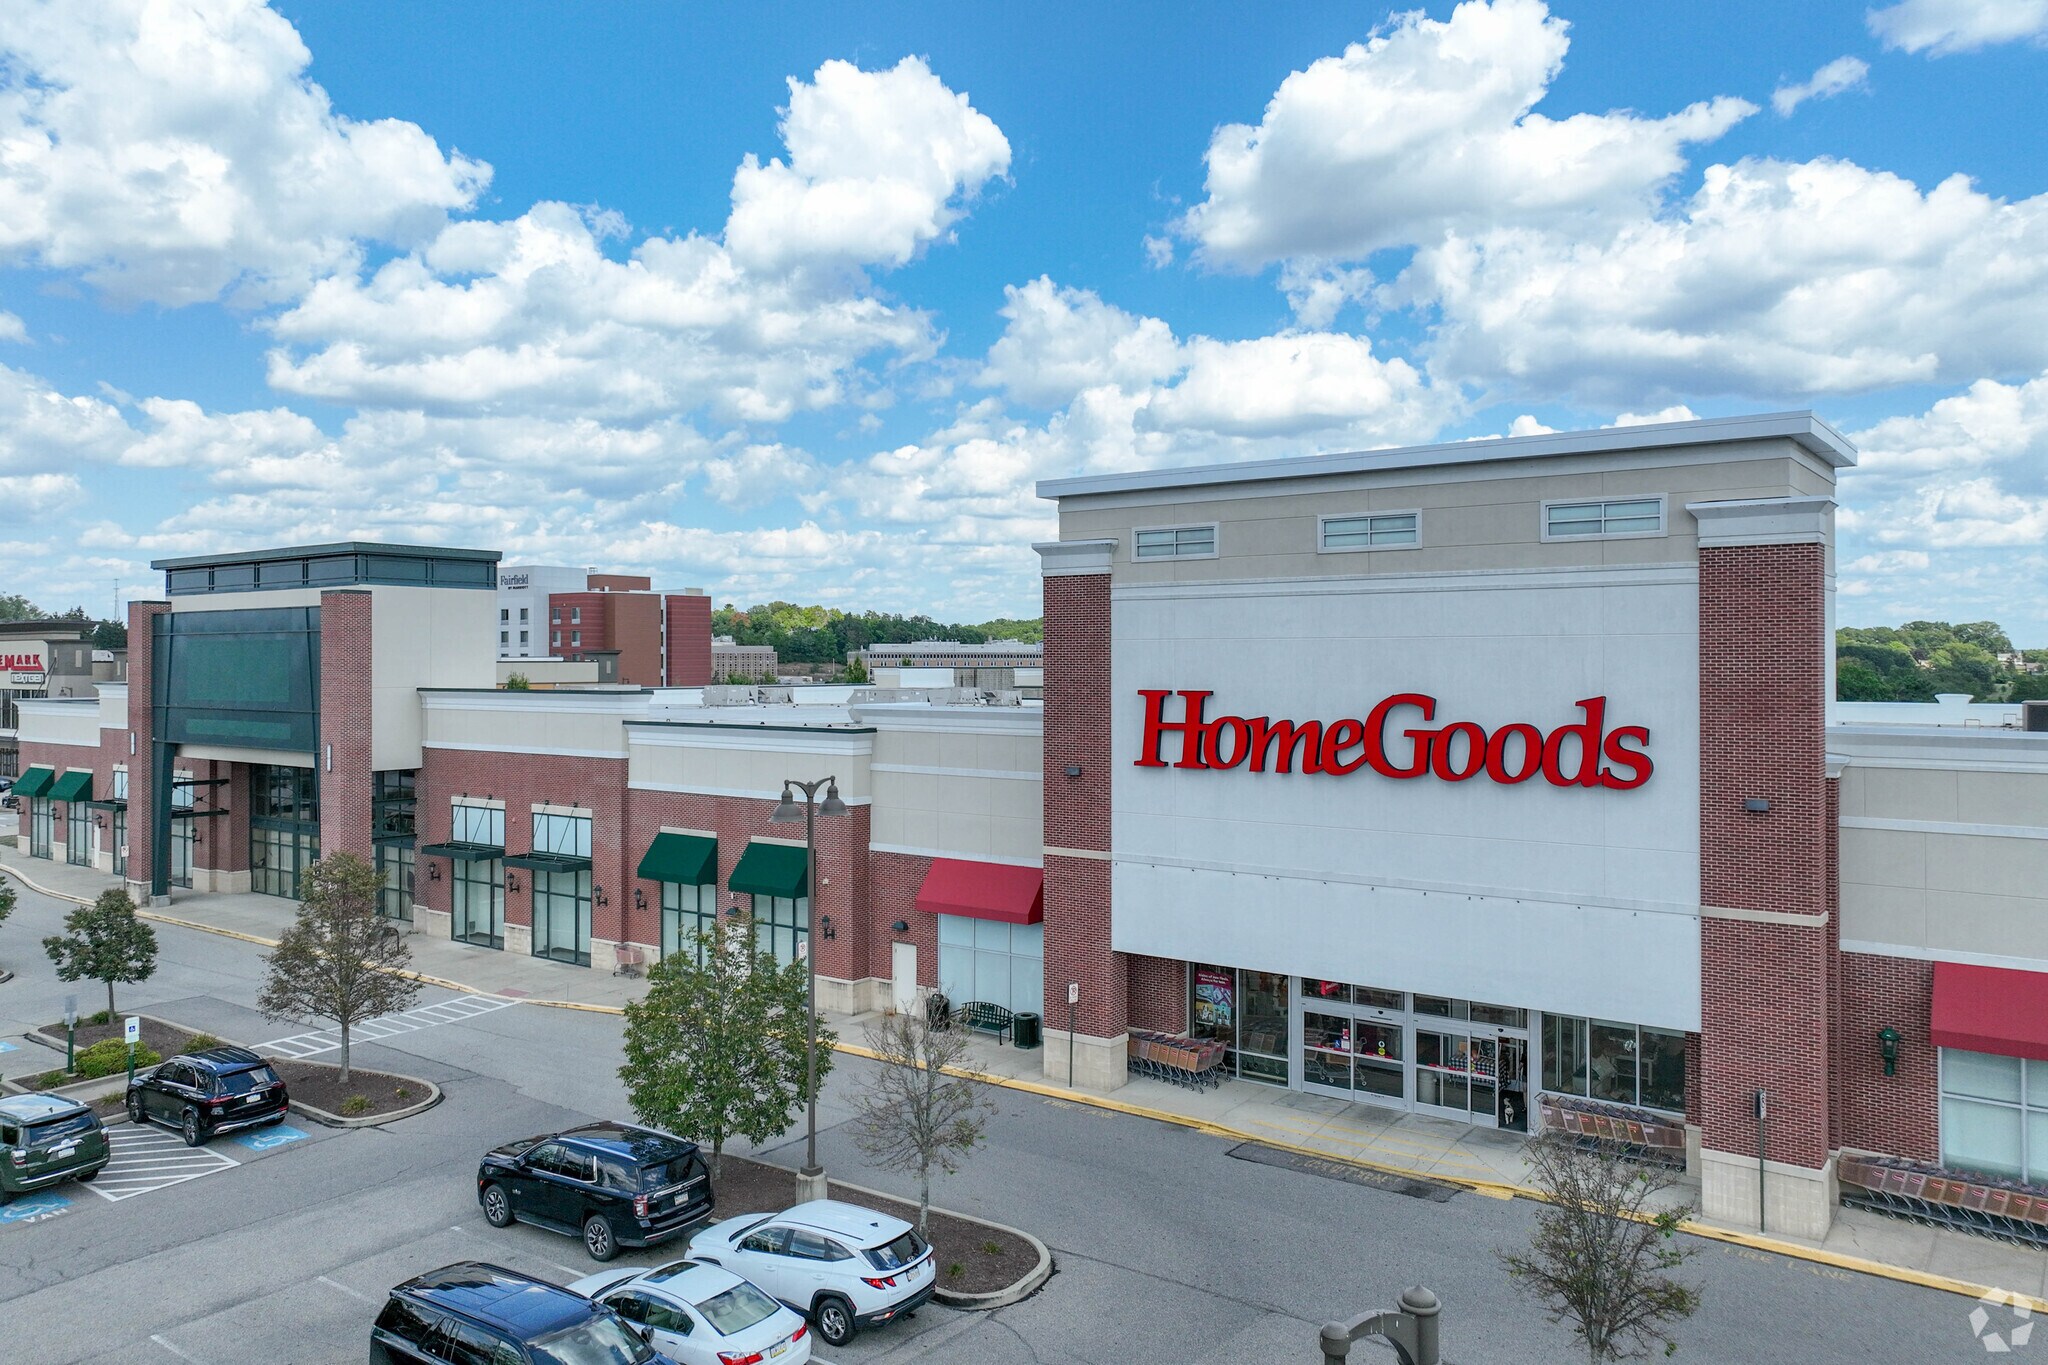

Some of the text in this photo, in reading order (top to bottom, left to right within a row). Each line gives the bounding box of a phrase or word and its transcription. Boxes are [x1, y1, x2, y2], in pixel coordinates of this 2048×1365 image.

[500, 573, 529, 586] Fairfield
[1133, 689, 1654, 790] HomeGoods
[22, 1207, 69, 1223] VAN
